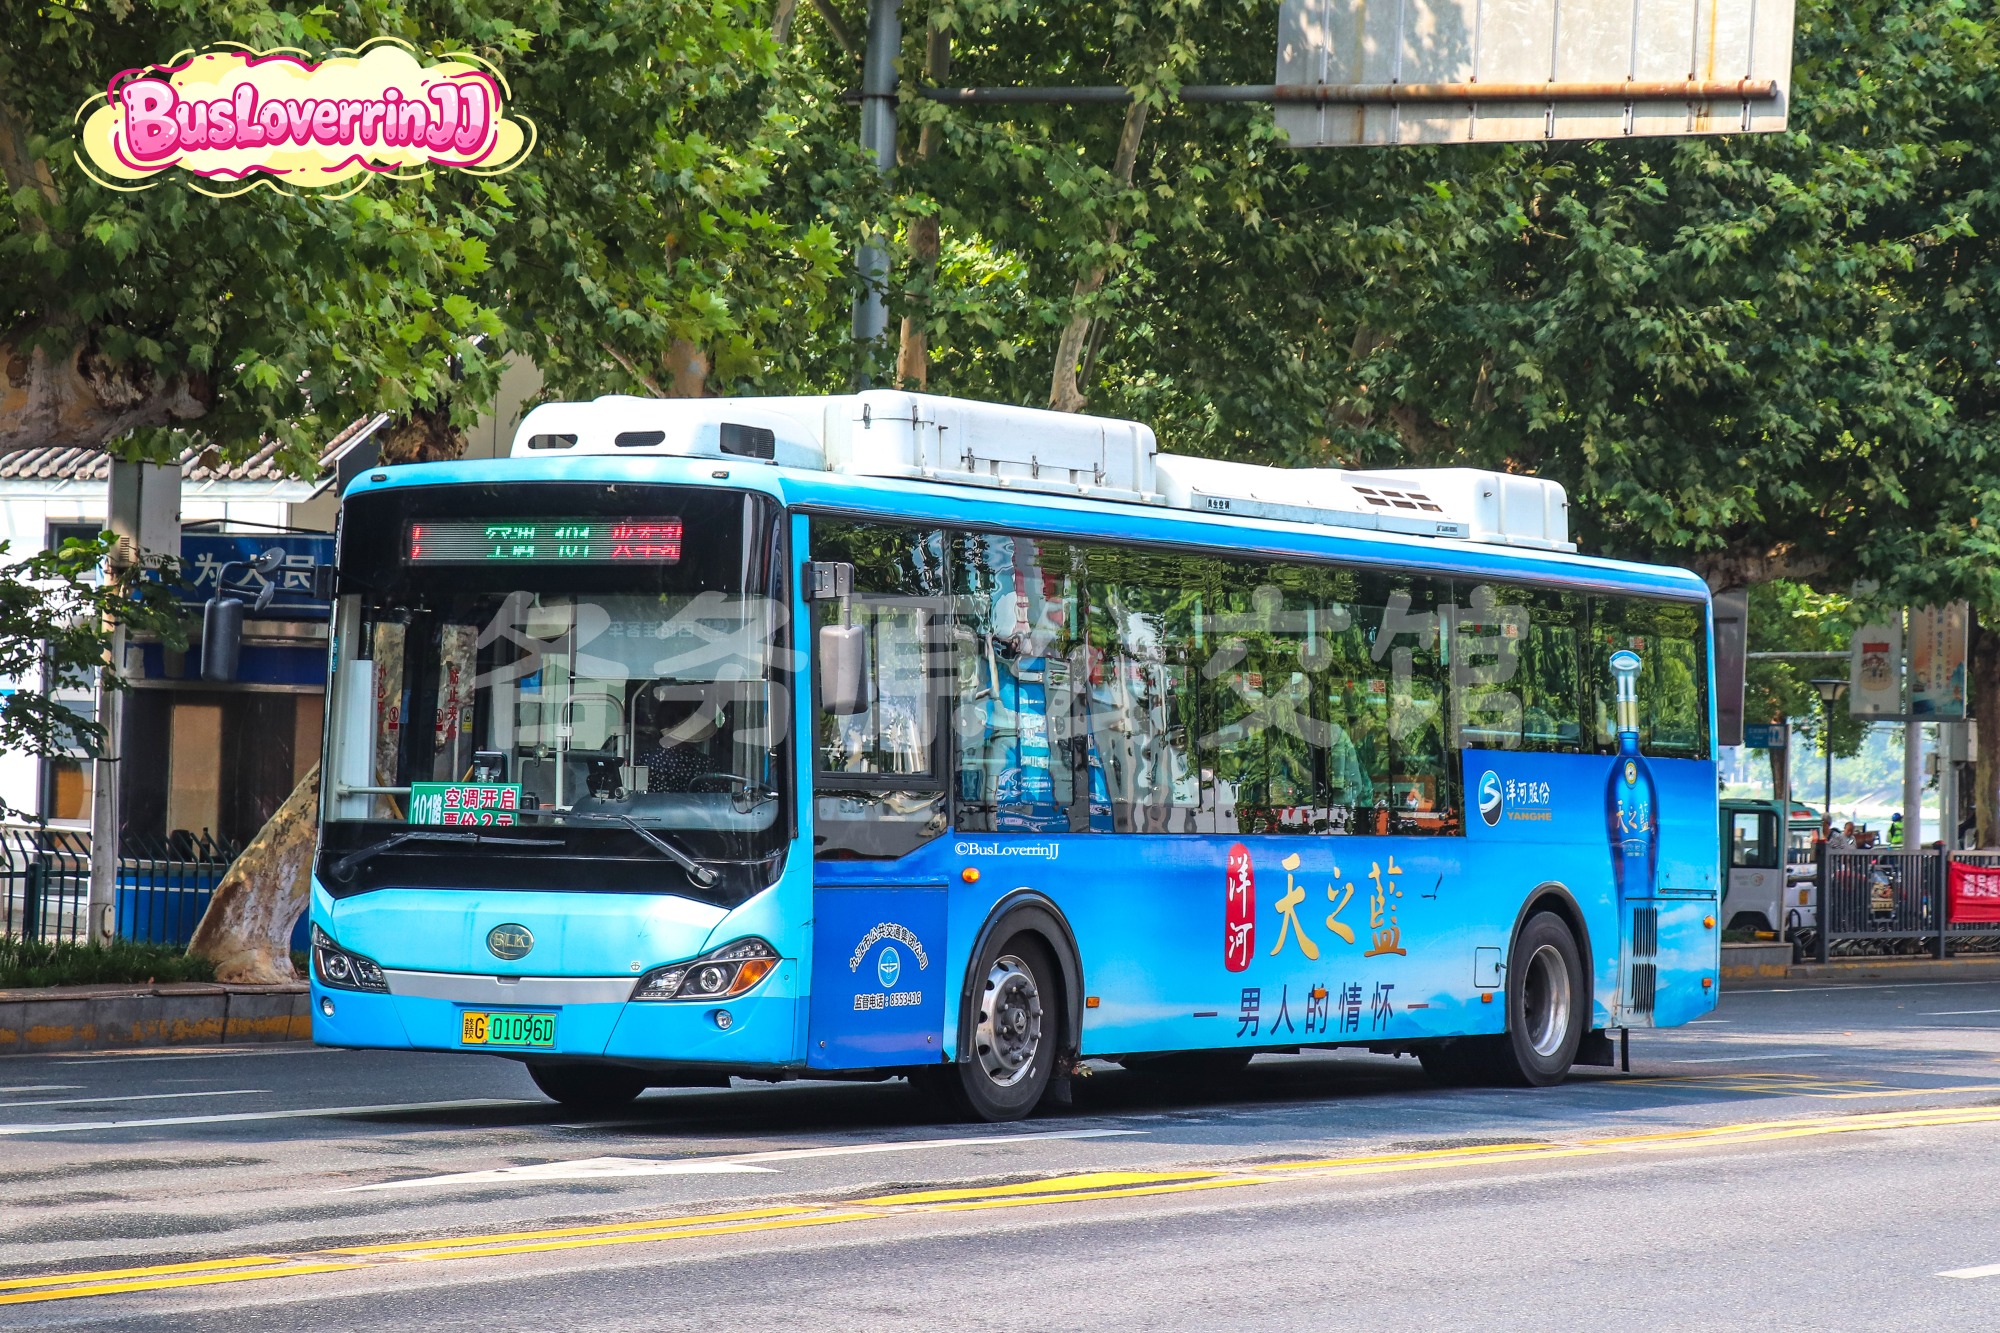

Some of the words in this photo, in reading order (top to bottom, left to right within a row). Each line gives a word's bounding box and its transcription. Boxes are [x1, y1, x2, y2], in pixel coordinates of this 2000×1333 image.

[158, 552, 316, 589] 为人民
[444, 787, 517, 810] 空调开启
[1506, 779, 1550, 808] 洋河股份
[1506, 811, 1552, 822] YANGHE
[1228, 853, 1253, 967] 洋河
